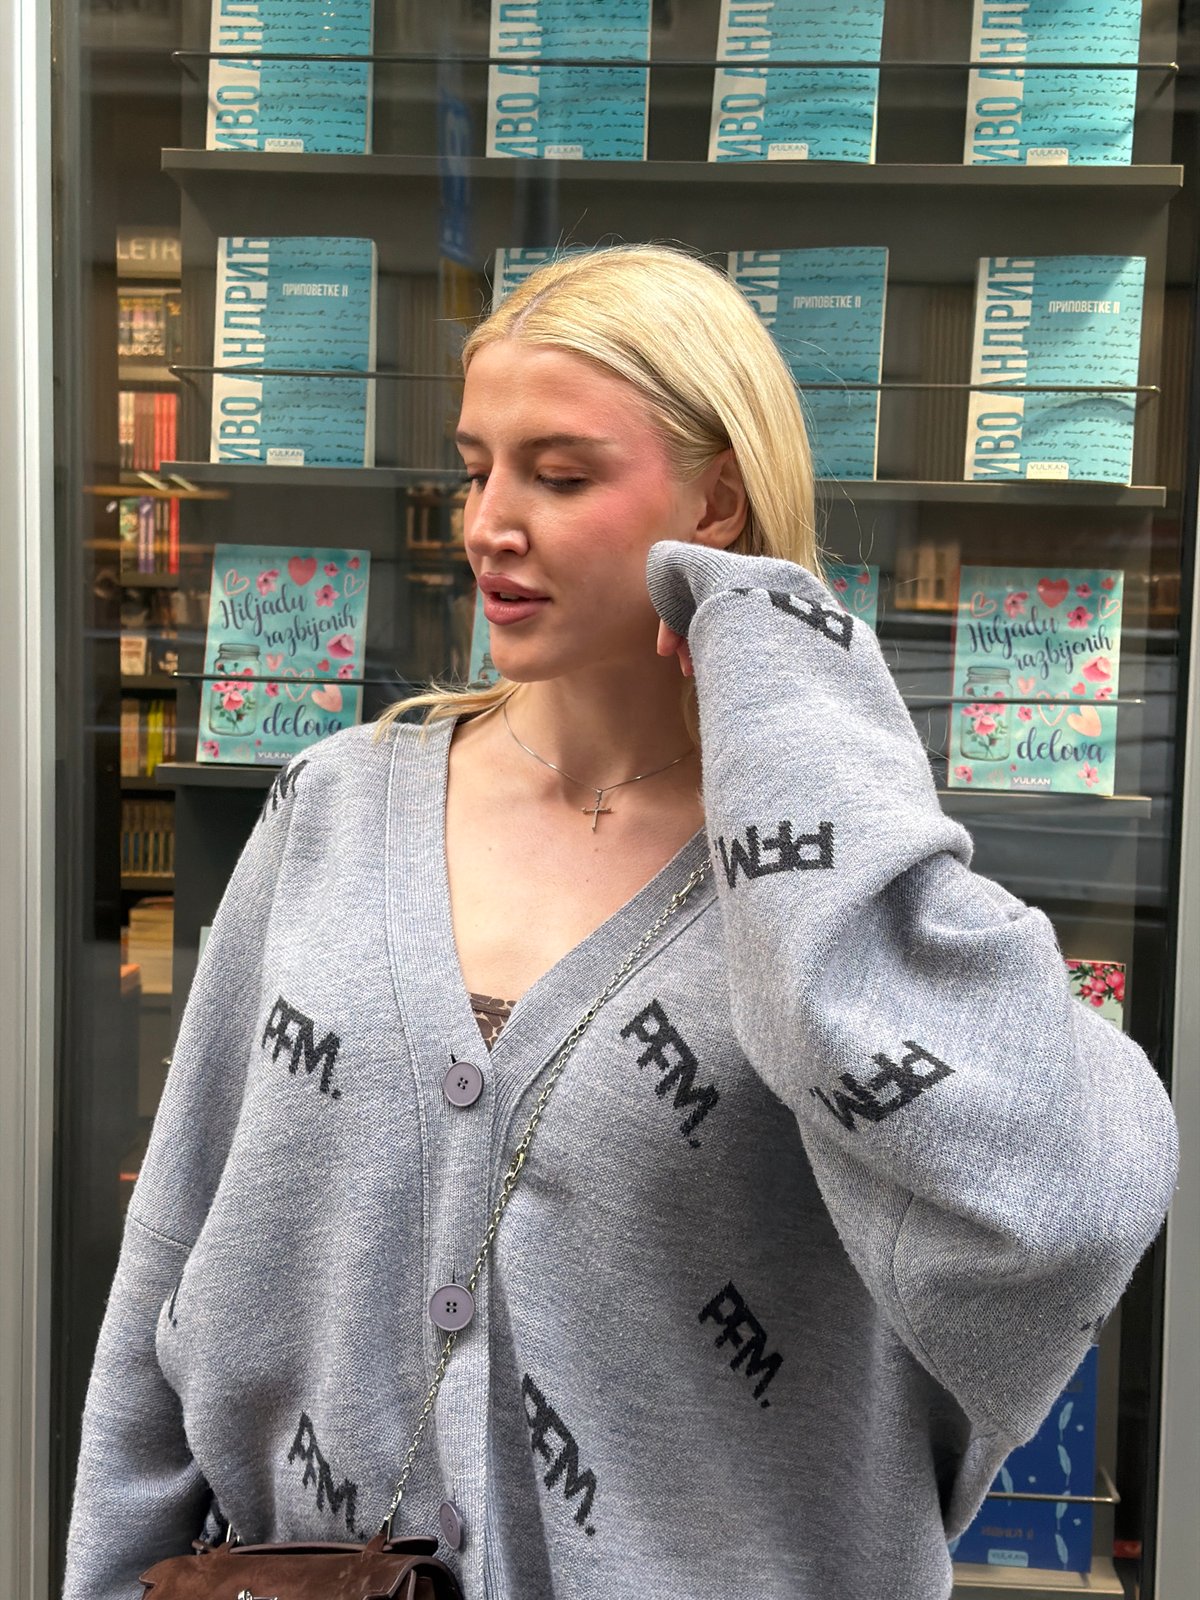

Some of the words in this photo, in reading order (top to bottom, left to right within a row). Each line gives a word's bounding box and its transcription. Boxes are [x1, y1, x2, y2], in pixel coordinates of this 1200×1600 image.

[972, 97, 1024, 165] ИВО
[267, 140, 302, 148] VULKAN
[770, 144, 807, 152] VULKAN
[1028, 148, 1067, 156] VULKAN
[282, 283, 340, 297] ПРИПОВЕТКЕ
[793, 295, 853, 309] ПРИПОВЕТКЕ
[1048, 300, 1110, 314] ПРИПОВЕТКЕ
[218, 397, 262, 465] ИВО
[972, 411, 1024, 480] ИВО
[268, 449, 303, 457] VULKAN
[1029, 463, 1067, 471] VULKAN
[218, 584, 308, 637] Hiljadu
[263, 602, 358, 657] razbijenih
[966, 606, 1060, 660] Hiljadu
[1013, 624, 1114, 680] razbijenih
[262, 702, 343, 737] delova
[1016, 726, 1107, 763] delova
[257, 751, 294, 760] VULKAN
[1012, 776, 1051, 785] VULKAN
